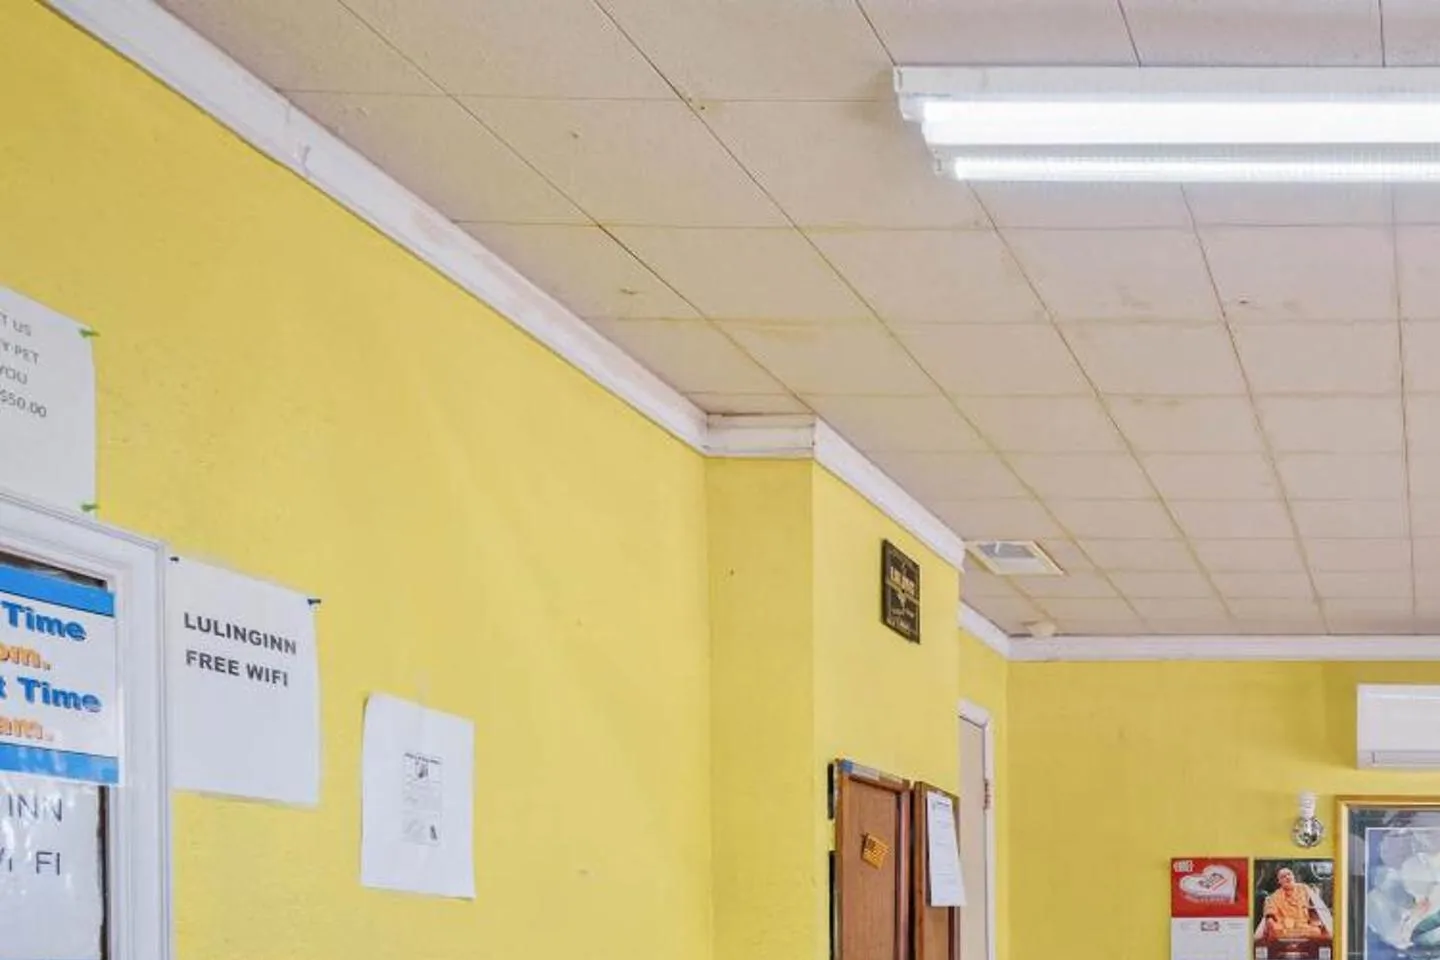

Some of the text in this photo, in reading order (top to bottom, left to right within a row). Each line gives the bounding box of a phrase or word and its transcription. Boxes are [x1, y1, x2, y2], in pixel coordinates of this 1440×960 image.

[1, 600, 87, 641] Time
[183, 611, 297, 655] LULINGINN
[185, 648, 289, 688] FREE WIFI
[17, 675, 102, 713] Time
[7, 792, 62, 822] INN
[35, 850, 61, 876] FI
